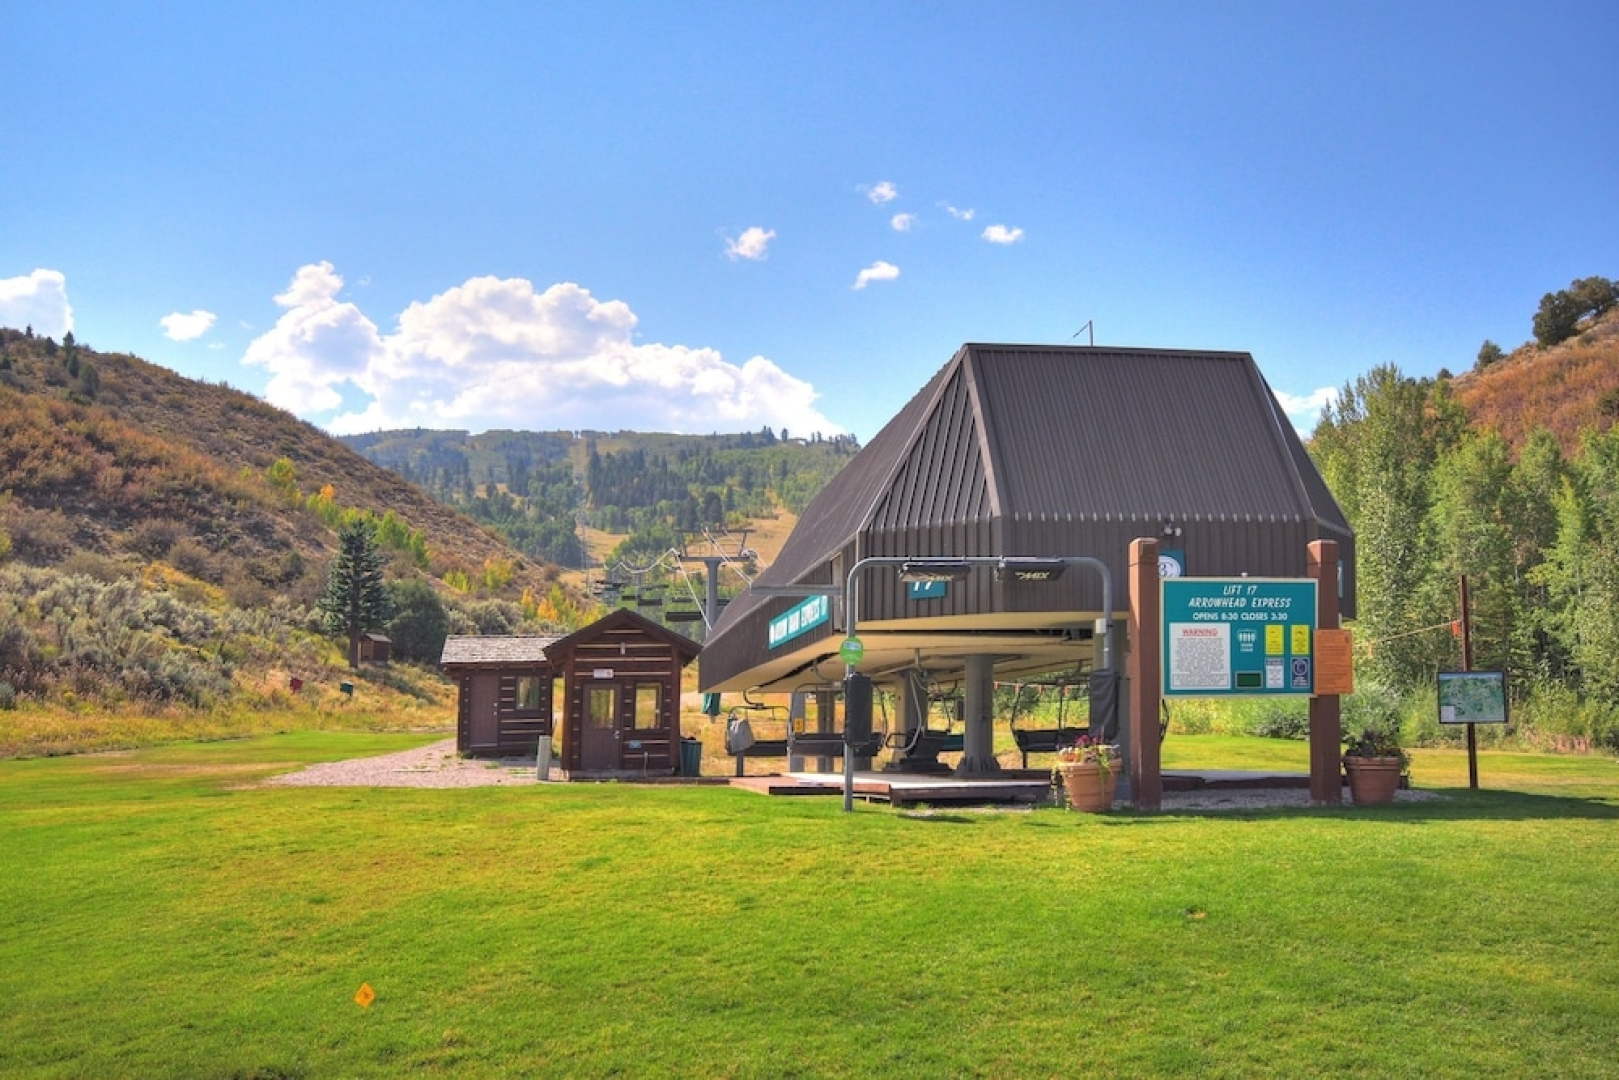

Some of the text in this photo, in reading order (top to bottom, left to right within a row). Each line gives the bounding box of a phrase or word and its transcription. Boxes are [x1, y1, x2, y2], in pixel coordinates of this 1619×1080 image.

[1223, 585, 1258, 595] LIFT 17
[1188, 597, 1292, 608] ARROWHEAD EXPRESS
[1192, 611, 1219, 621] OPENS
[1241, 611, 1268, 621] CLOSES
[1181, 628, 1218, 637] WARNING
